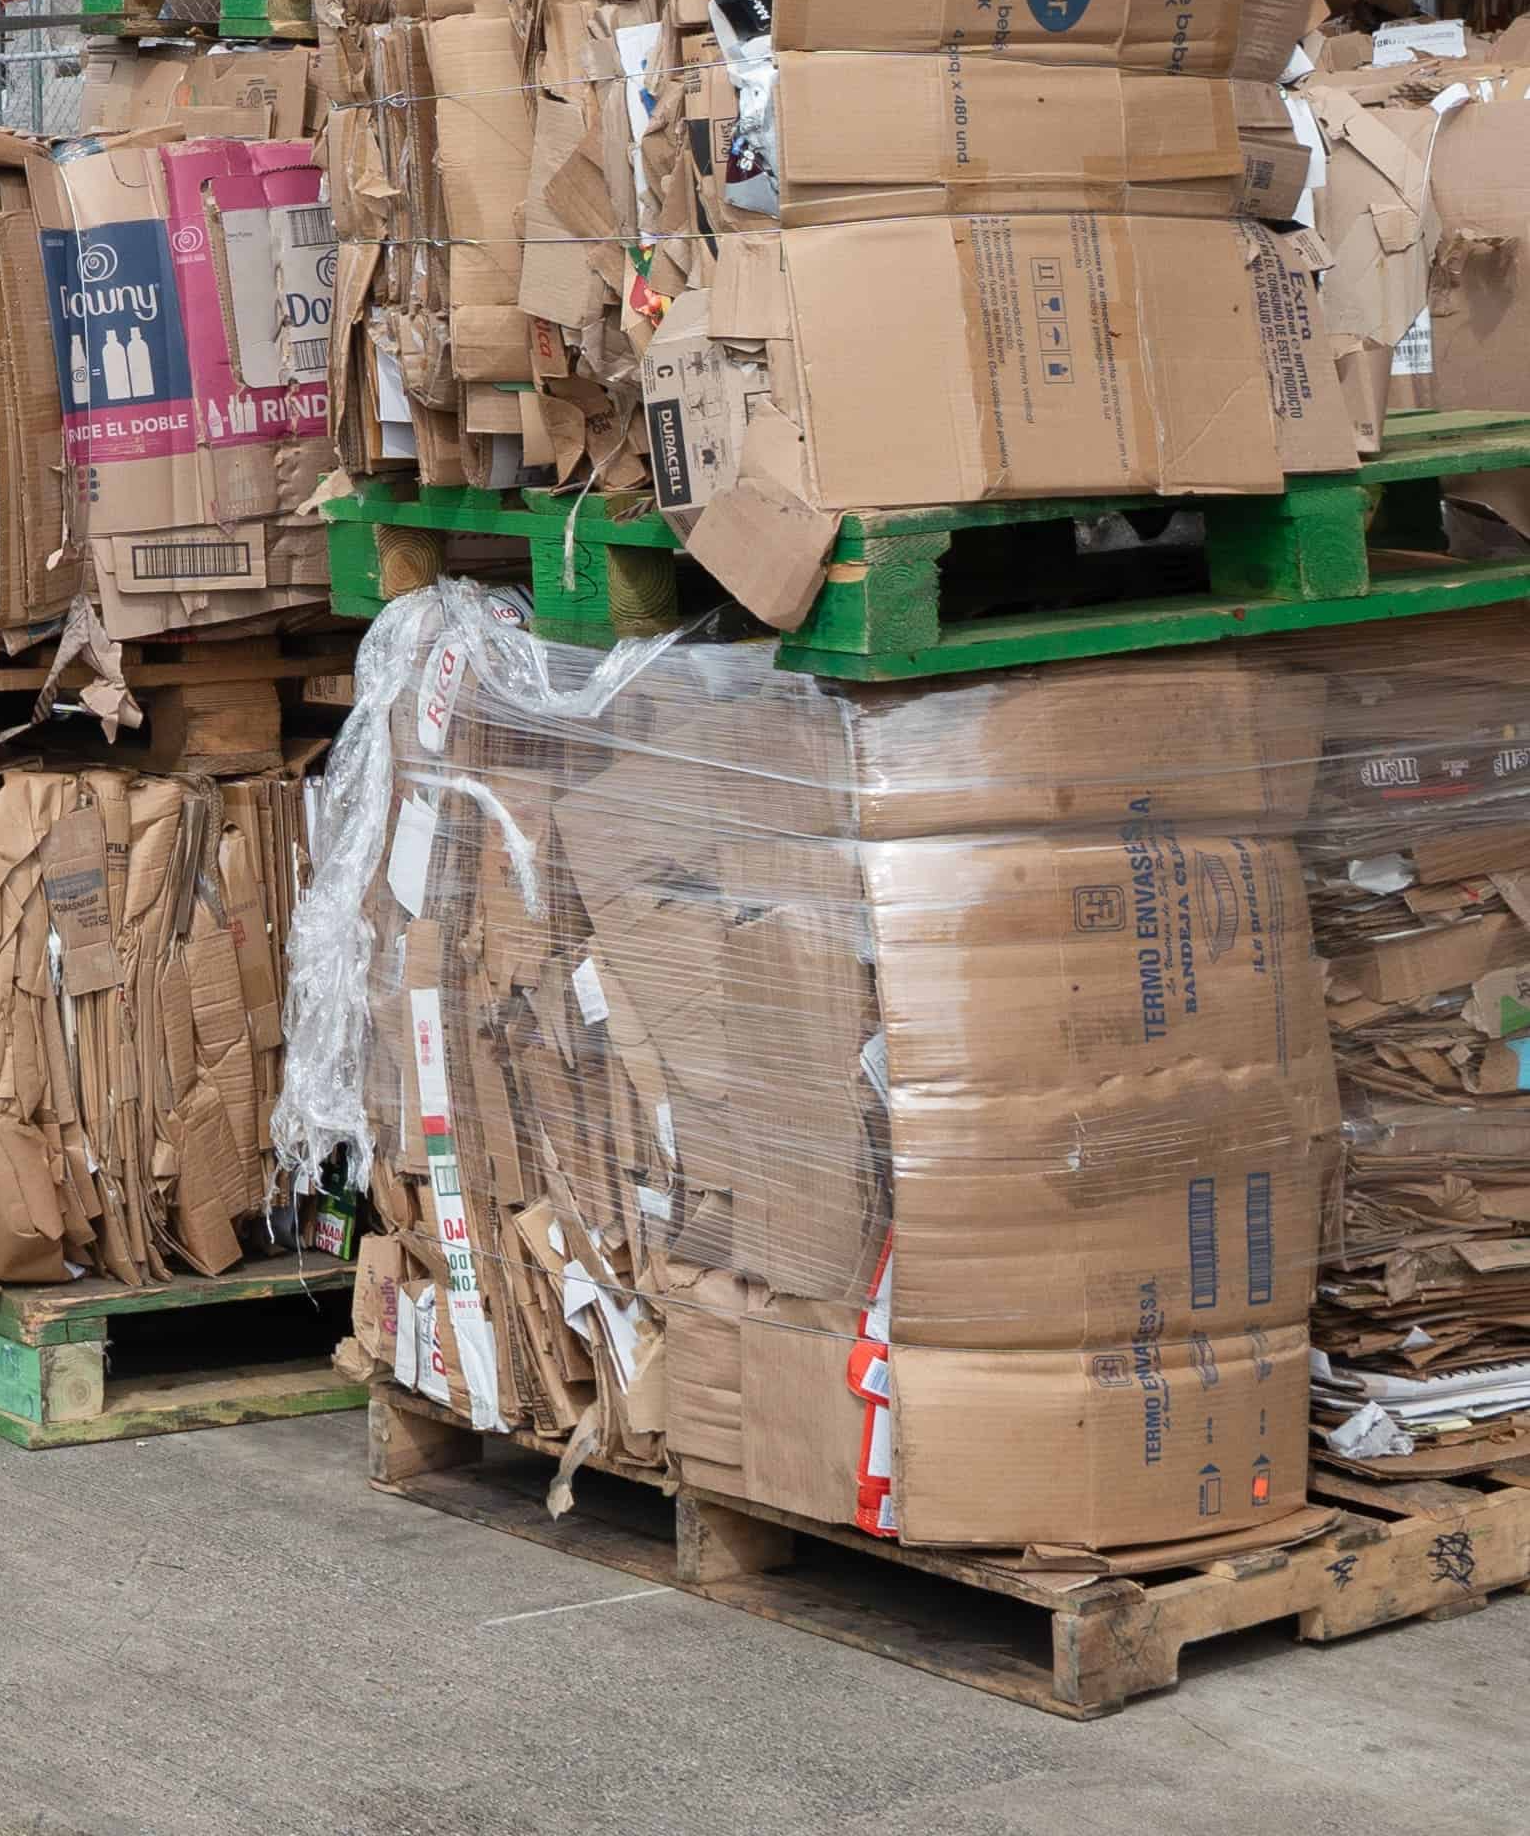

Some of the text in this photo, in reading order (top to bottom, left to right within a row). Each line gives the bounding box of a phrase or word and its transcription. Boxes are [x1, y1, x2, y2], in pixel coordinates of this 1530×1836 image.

[953, 94, 968, 125] 480
[1263, 257, 1275, 271] EL
[1256, 290, 1272, 326] SALUD
[1266, 272, 1284, 322] CONSUMO
[1289, 270, 1314, 341] Extra
[1274, 323, 1287, 338] DE
[657, 364, 674, 379] C
[1278, 339, 1292, 366] ESTE
[1283, 365, 1303, 420] PRODUCTO
[107, 422, 130, 439] EL
[131, 413, 189, 435] DOBLE
[660, 409, 683, 496] DURACELL
[426, 648, 457, 729] Rica
[1177, 893, 1198, 1014] BANDEJA
[1144, 1397, 1162, 1467] TERMO
